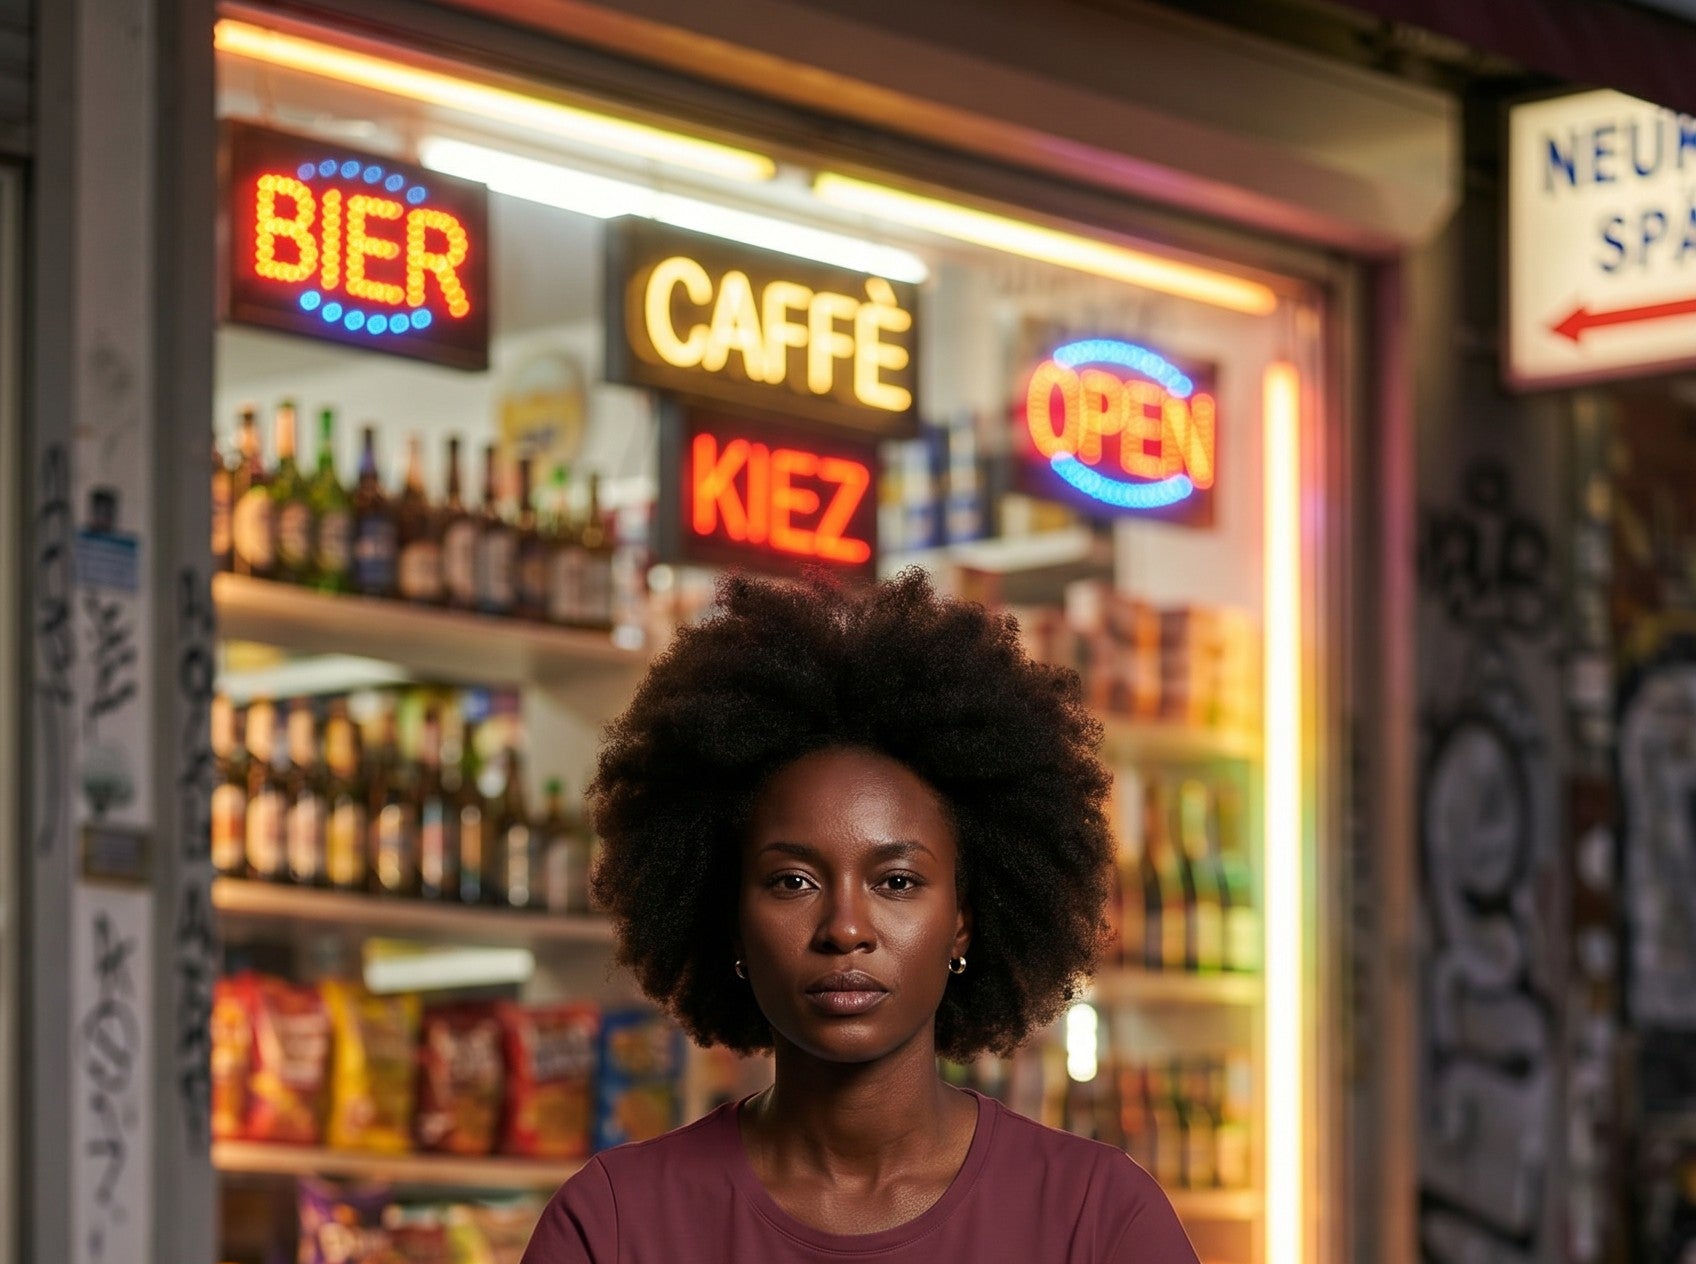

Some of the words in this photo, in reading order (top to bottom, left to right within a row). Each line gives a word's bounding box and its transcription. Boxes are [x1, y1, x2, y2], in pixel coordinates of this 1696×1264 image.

[255, 174, 470, 317] BIER
[645, 256, 913, 411] CAFFÈ
[1026, 360, 1217, 489] OPEN
[692, 432, 873, 564] KIEZ
